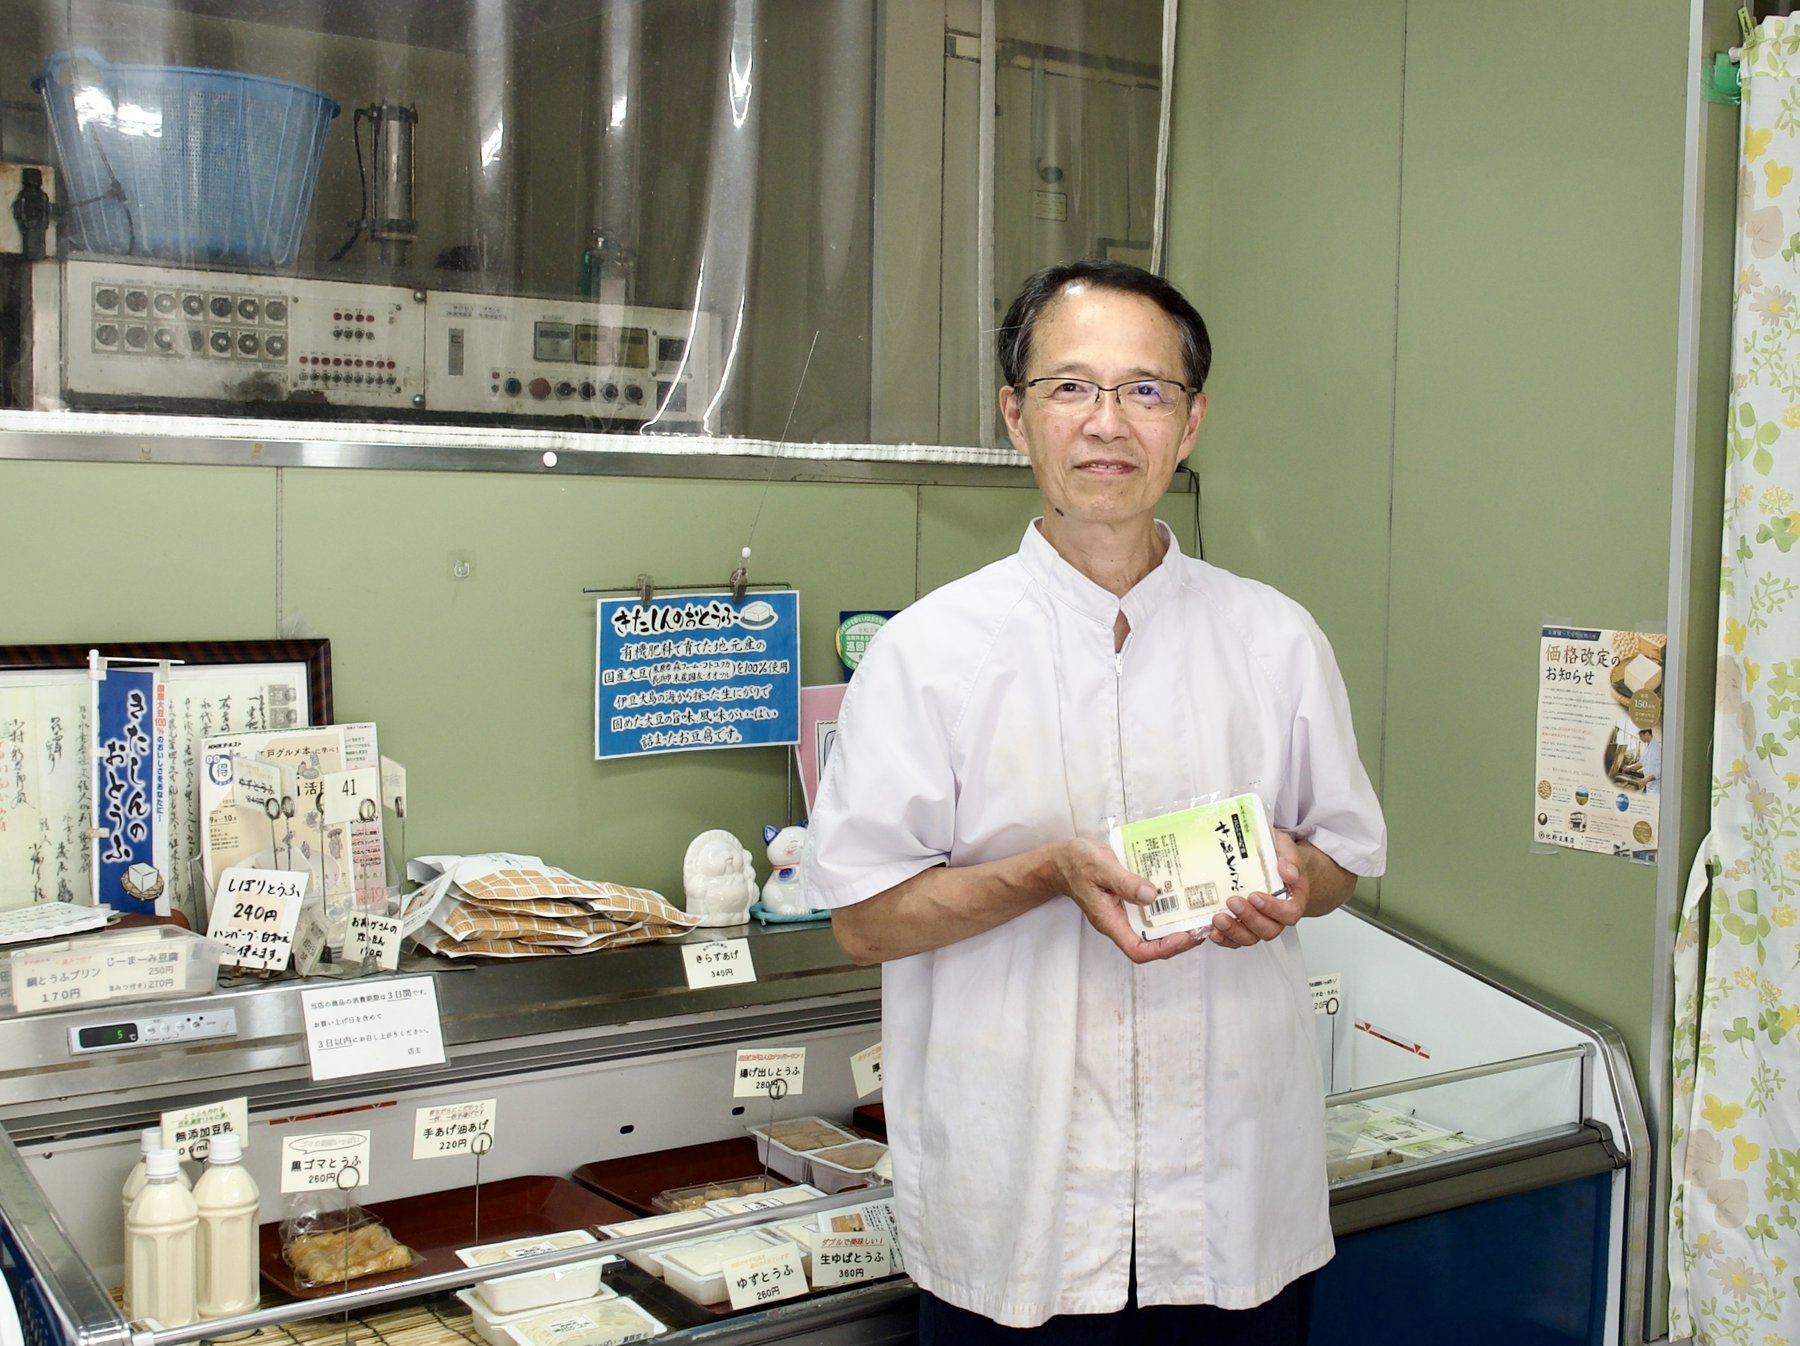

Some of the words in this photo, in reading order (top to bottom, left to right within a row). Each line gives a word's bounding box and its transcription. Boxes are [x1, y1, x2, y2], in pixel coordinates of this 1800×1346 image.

[614, 604, 739, 633] きたしんのおとうふ
[620, 638, 765, 660] 有機肥料で育てた地元産の
[1546, 644, 1620, 668] 価格改定の
[1545, 666, 1595, 685] お知らせ
[260, 746, 339, 758] 戸グルメ本に学べ!
[128, 692, 149, 839] きたしんの
[342, 778, 357, 797] 41
[106, 741, 131, 860] おとうふ
[228, 878, 300, 898] しぼりとうふ
[233, 903, 278, 922] 240円
[696, 949, 739, 964] きらずあげ
[148, 966, 174, 976] 250円
[711, 968, 733, 978] 340円
[148, 978, 174, 988] 270円
[42, 988, 81, 1003] 170円
[740, 1067, 801, 1078] 揚げ出しとうふ
[755, 1080, 779, 1089] 280円
[176, 1122, 234, 1142] 無添加豆乳
[423, 1119, 489, 1139] 手あげ油あげ
[440, 1138, 467, 1150] 220円
[291, 1156, 361, 1172] 黒ゴマとうふ
[308, 1173, 336, 1184] 260円
[820, 1251, 884, 1265] 生ゆばとうふ
[736, 1264, 794, 1289] ゆずとうふ
[839, 1268, 864, 1278] 360円
[757, 1286, 780, 1300] 260円
